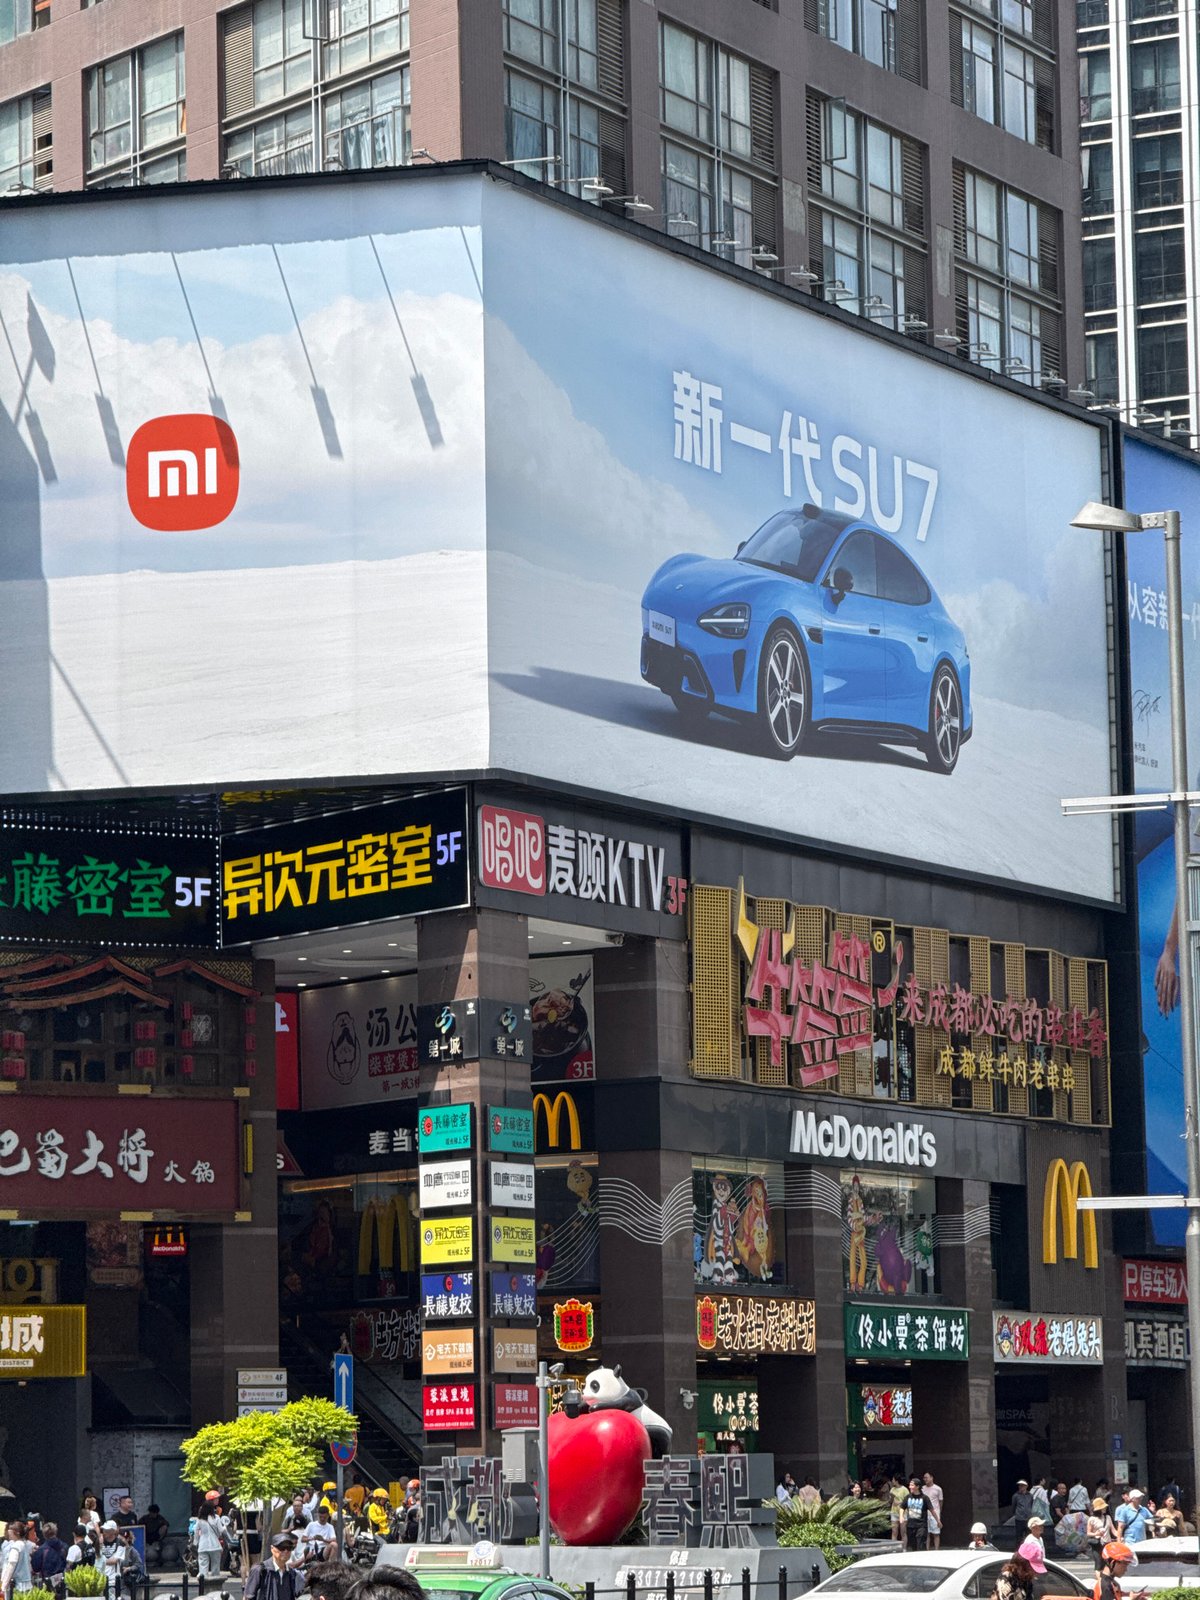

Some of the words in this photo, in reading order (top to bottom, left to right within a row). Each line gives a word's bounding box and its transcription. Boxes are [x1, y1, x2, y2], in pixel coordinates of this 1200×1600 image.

[673, 370, 939, 542] 新一代SU7
[0, 852, 172, 918] 藤密室
[175, 876, 212, 907] 5F
[223, 824, 432, 920] 异次元密室
[436, 830, 462, 866] 5F
[548, 825, 665, 911] 麦颂KTV
[667, 876, 688, 916] 3F
[901, 974, 1107, 1057] 来成都必吃的串串香
[429, 1036, 462, 1058] 第一城
[496, 1036, 524, 1057] 第一城
[573, 1061, 593, 1079] 3F
[937, 1046, 1075, 1093] 成都鲜牛肉老串串
[369, 1128, 418, 1156] 麦当
[790, 1110, 937, 1168] McDonald's
[164, 1160, 215, 1183] 火锅
[463, 1273, 472, 1285] 5F
[526, 1274, 535, 1287] 5F
[418, 1456, 514, 1544] 成都
[642, 1454, 757, 1547] 春熙
